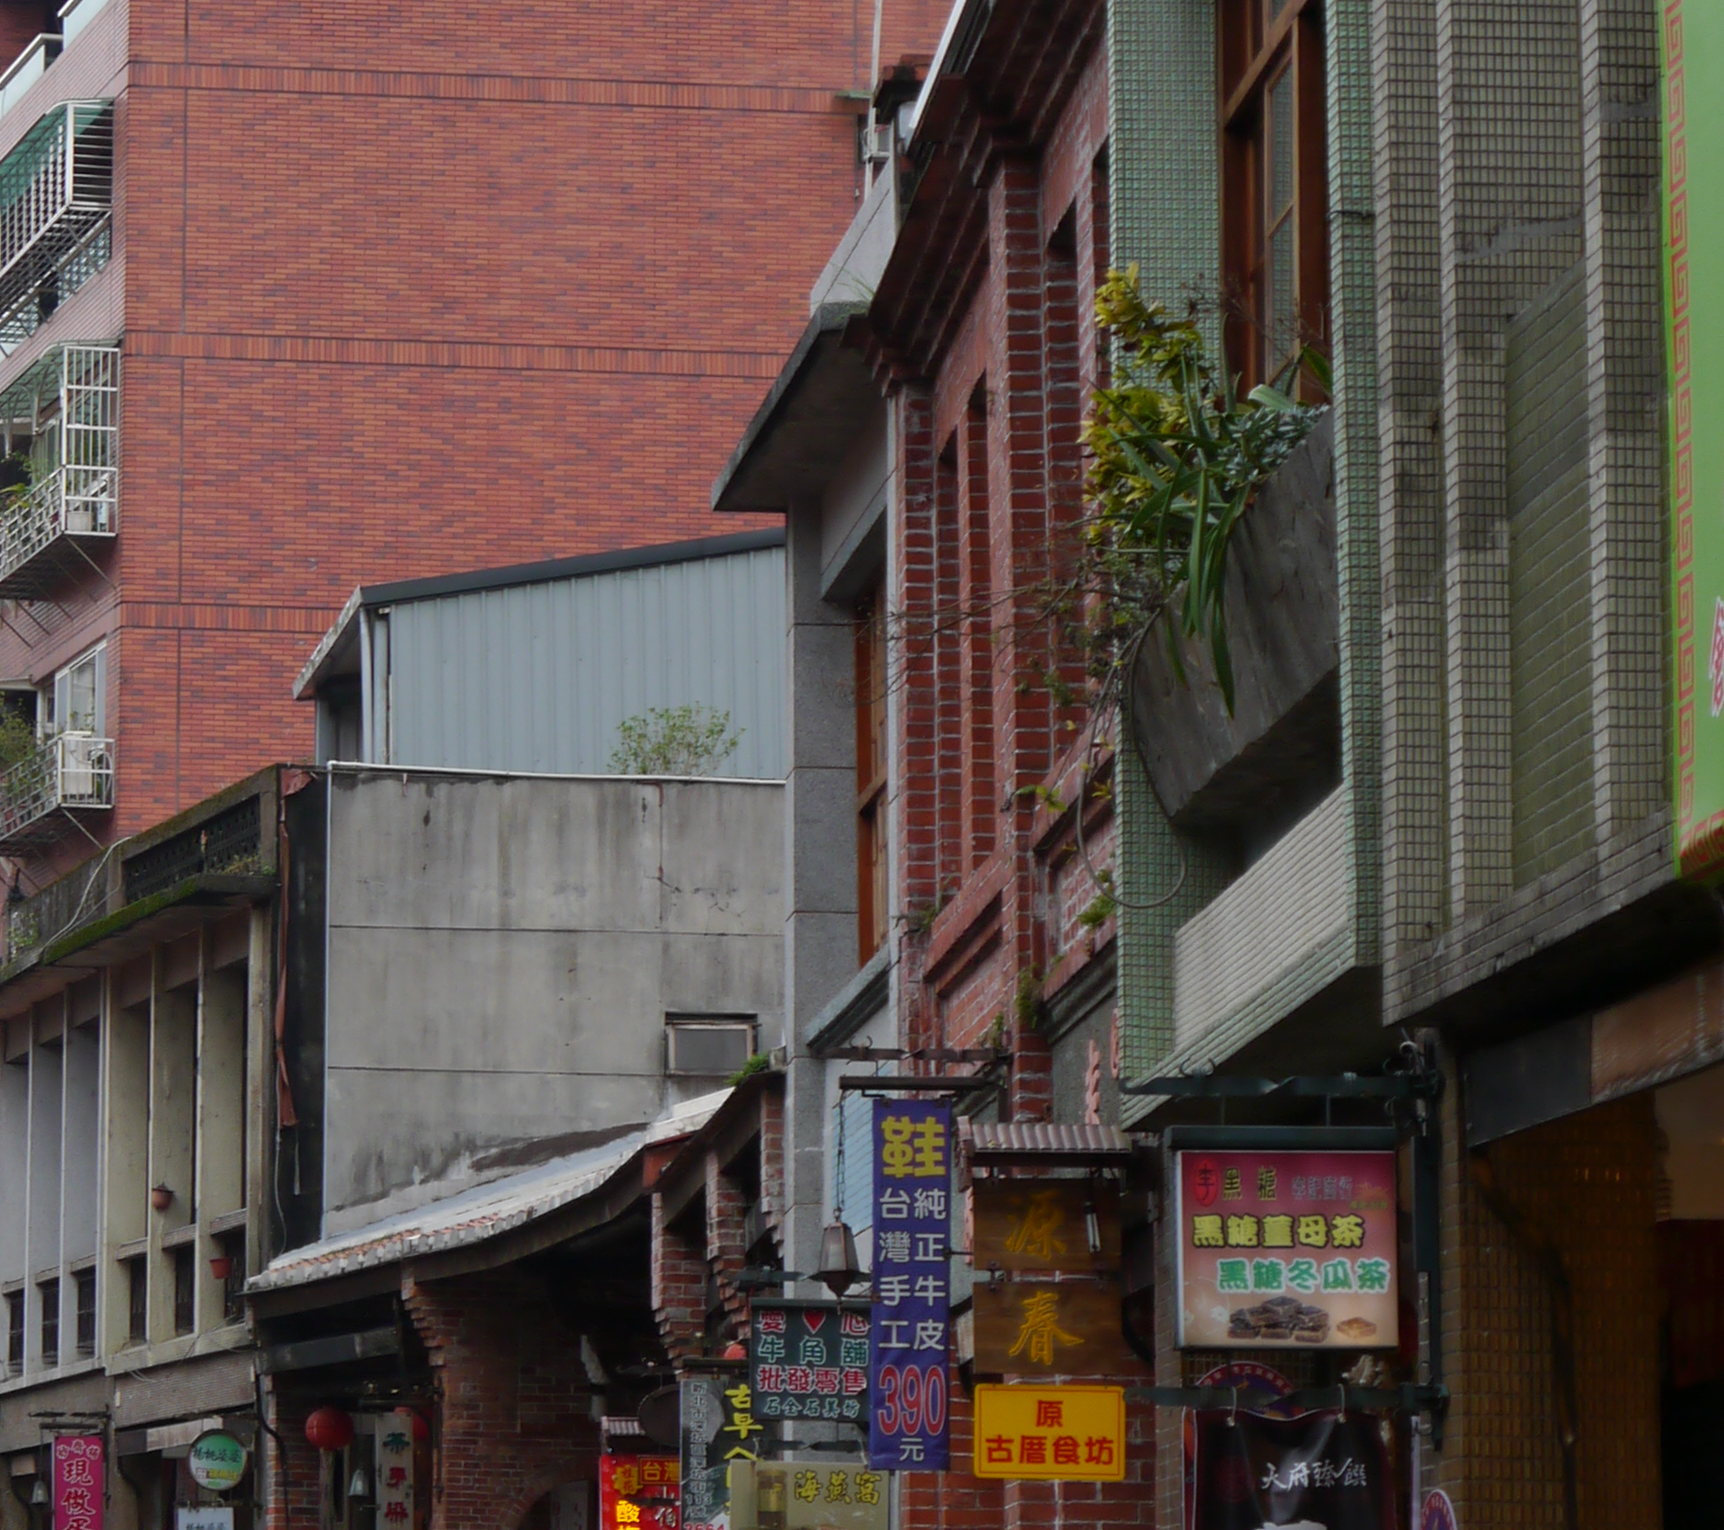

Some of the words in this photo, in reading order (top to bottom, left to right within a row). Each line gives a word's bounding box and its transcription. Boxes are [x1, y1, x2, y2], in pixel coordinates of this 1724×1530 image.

[881, 1116, 946, 1178] 鞋
[1192, 1213, 1365, 1248] 黑糖薑母茶
[878, 1187, 912, 1350] 台灣手工
[913, 1187, 947, 1352] 純正牛皮
[1217, 1257, 1391, 1294] 黑糖冬瓜茶
[756, 1364, 868, 1395] 批發零售
[878, 1365, 947, 1436] 390
[1035, 1399, 1064, 1429] 原
[898, 1437, 926, 1463] 元
[984, 1434, 1115, 1467] 古厝食坊
[794, 1470, 883, 1505] 海燕窩
